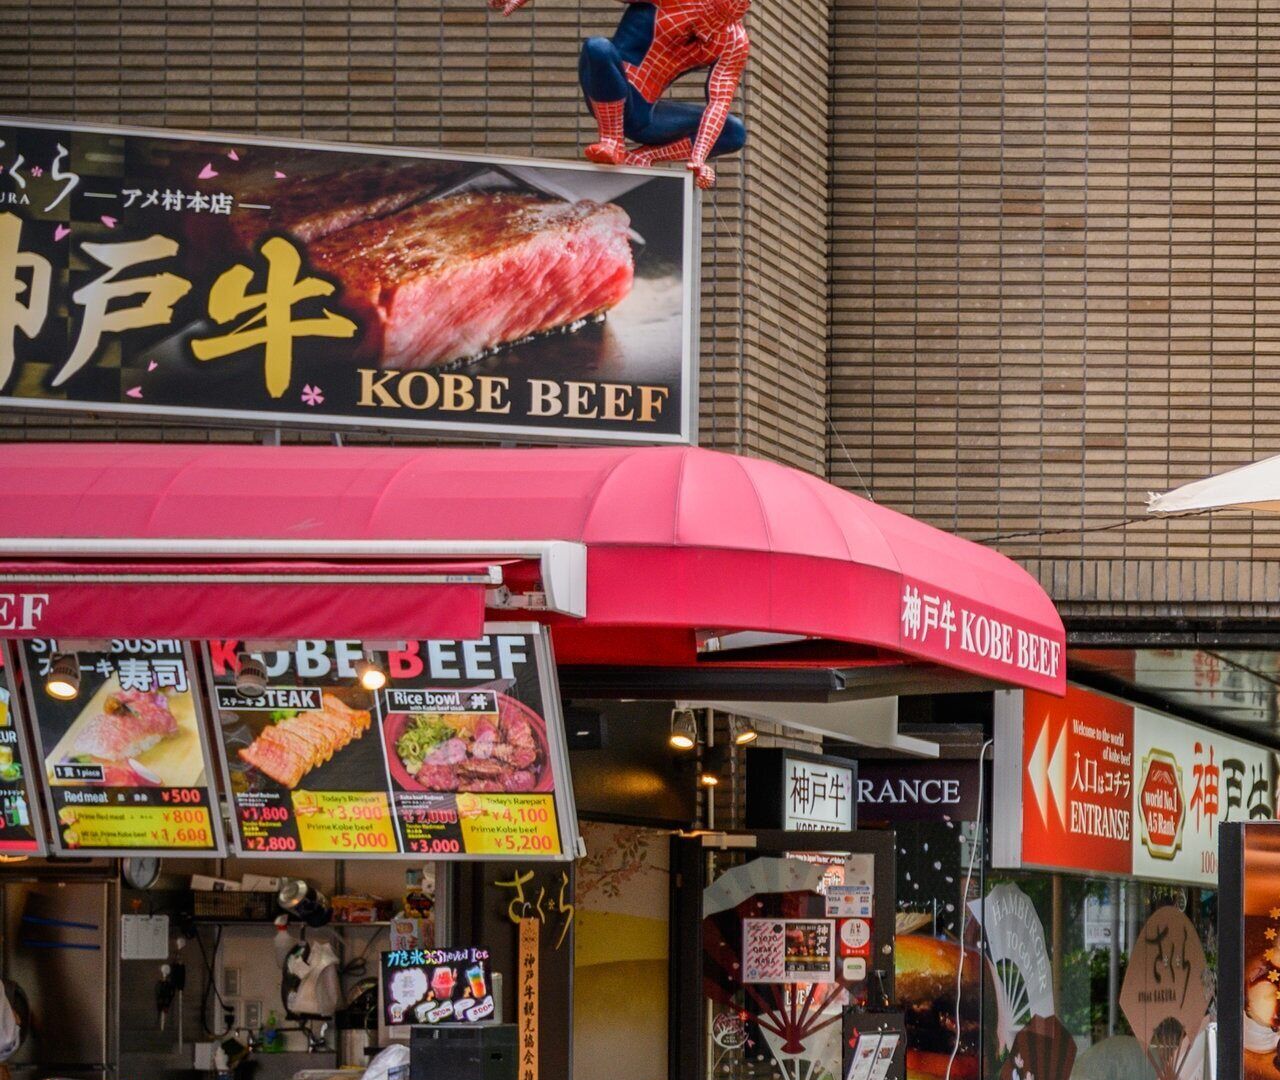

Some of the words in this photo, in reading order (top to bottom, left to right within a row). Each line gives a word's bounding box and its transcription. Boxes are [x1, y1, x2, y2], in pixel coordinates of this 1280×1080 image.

[121, 187, 234, 215] アメ村本店
[356, 368, 511, 415] KOBE
[526, 378, 670, 423] BEEF
[902, 584, 957, 650] 神戸牛
[960, 608, 1014, 665] KOBE
[1016, 628, 1061, 678] BEEF
[387, 635, 528, 680] BEEF
[394, 692, 421, 706] Rice
[424, 692, 460, 706] bowl
[1073, 719, 1097, 739] Welcome
[1101, 728, 1111, 742] the
[1110, 731, 1125, 747] world
[1070, 751, 1131, 799] 入口はコチラ
[789, 766, 847, 818] 神戸牛
[1145, 787, 1163, 809] world
[162, 809, 205, 824] ¥800
[327, 806, 383, 822] ¥3,900
[493, 808, 549, 825] ¥4,100
[1070, 800, 1131, 841] ENTRANSE
[1147, 810, 1158, 833] A5
[1157, 812, 1176, 836] Rank
[246, 836, 297, 851] ¥2,800
[331, 832, 388, 849] ¥5,000
[410, 839, 460, 854] ¥3,000
[494, 834, 553, 851] ¥5,200
[992, 895, 1048, 992] HAMBURGER
